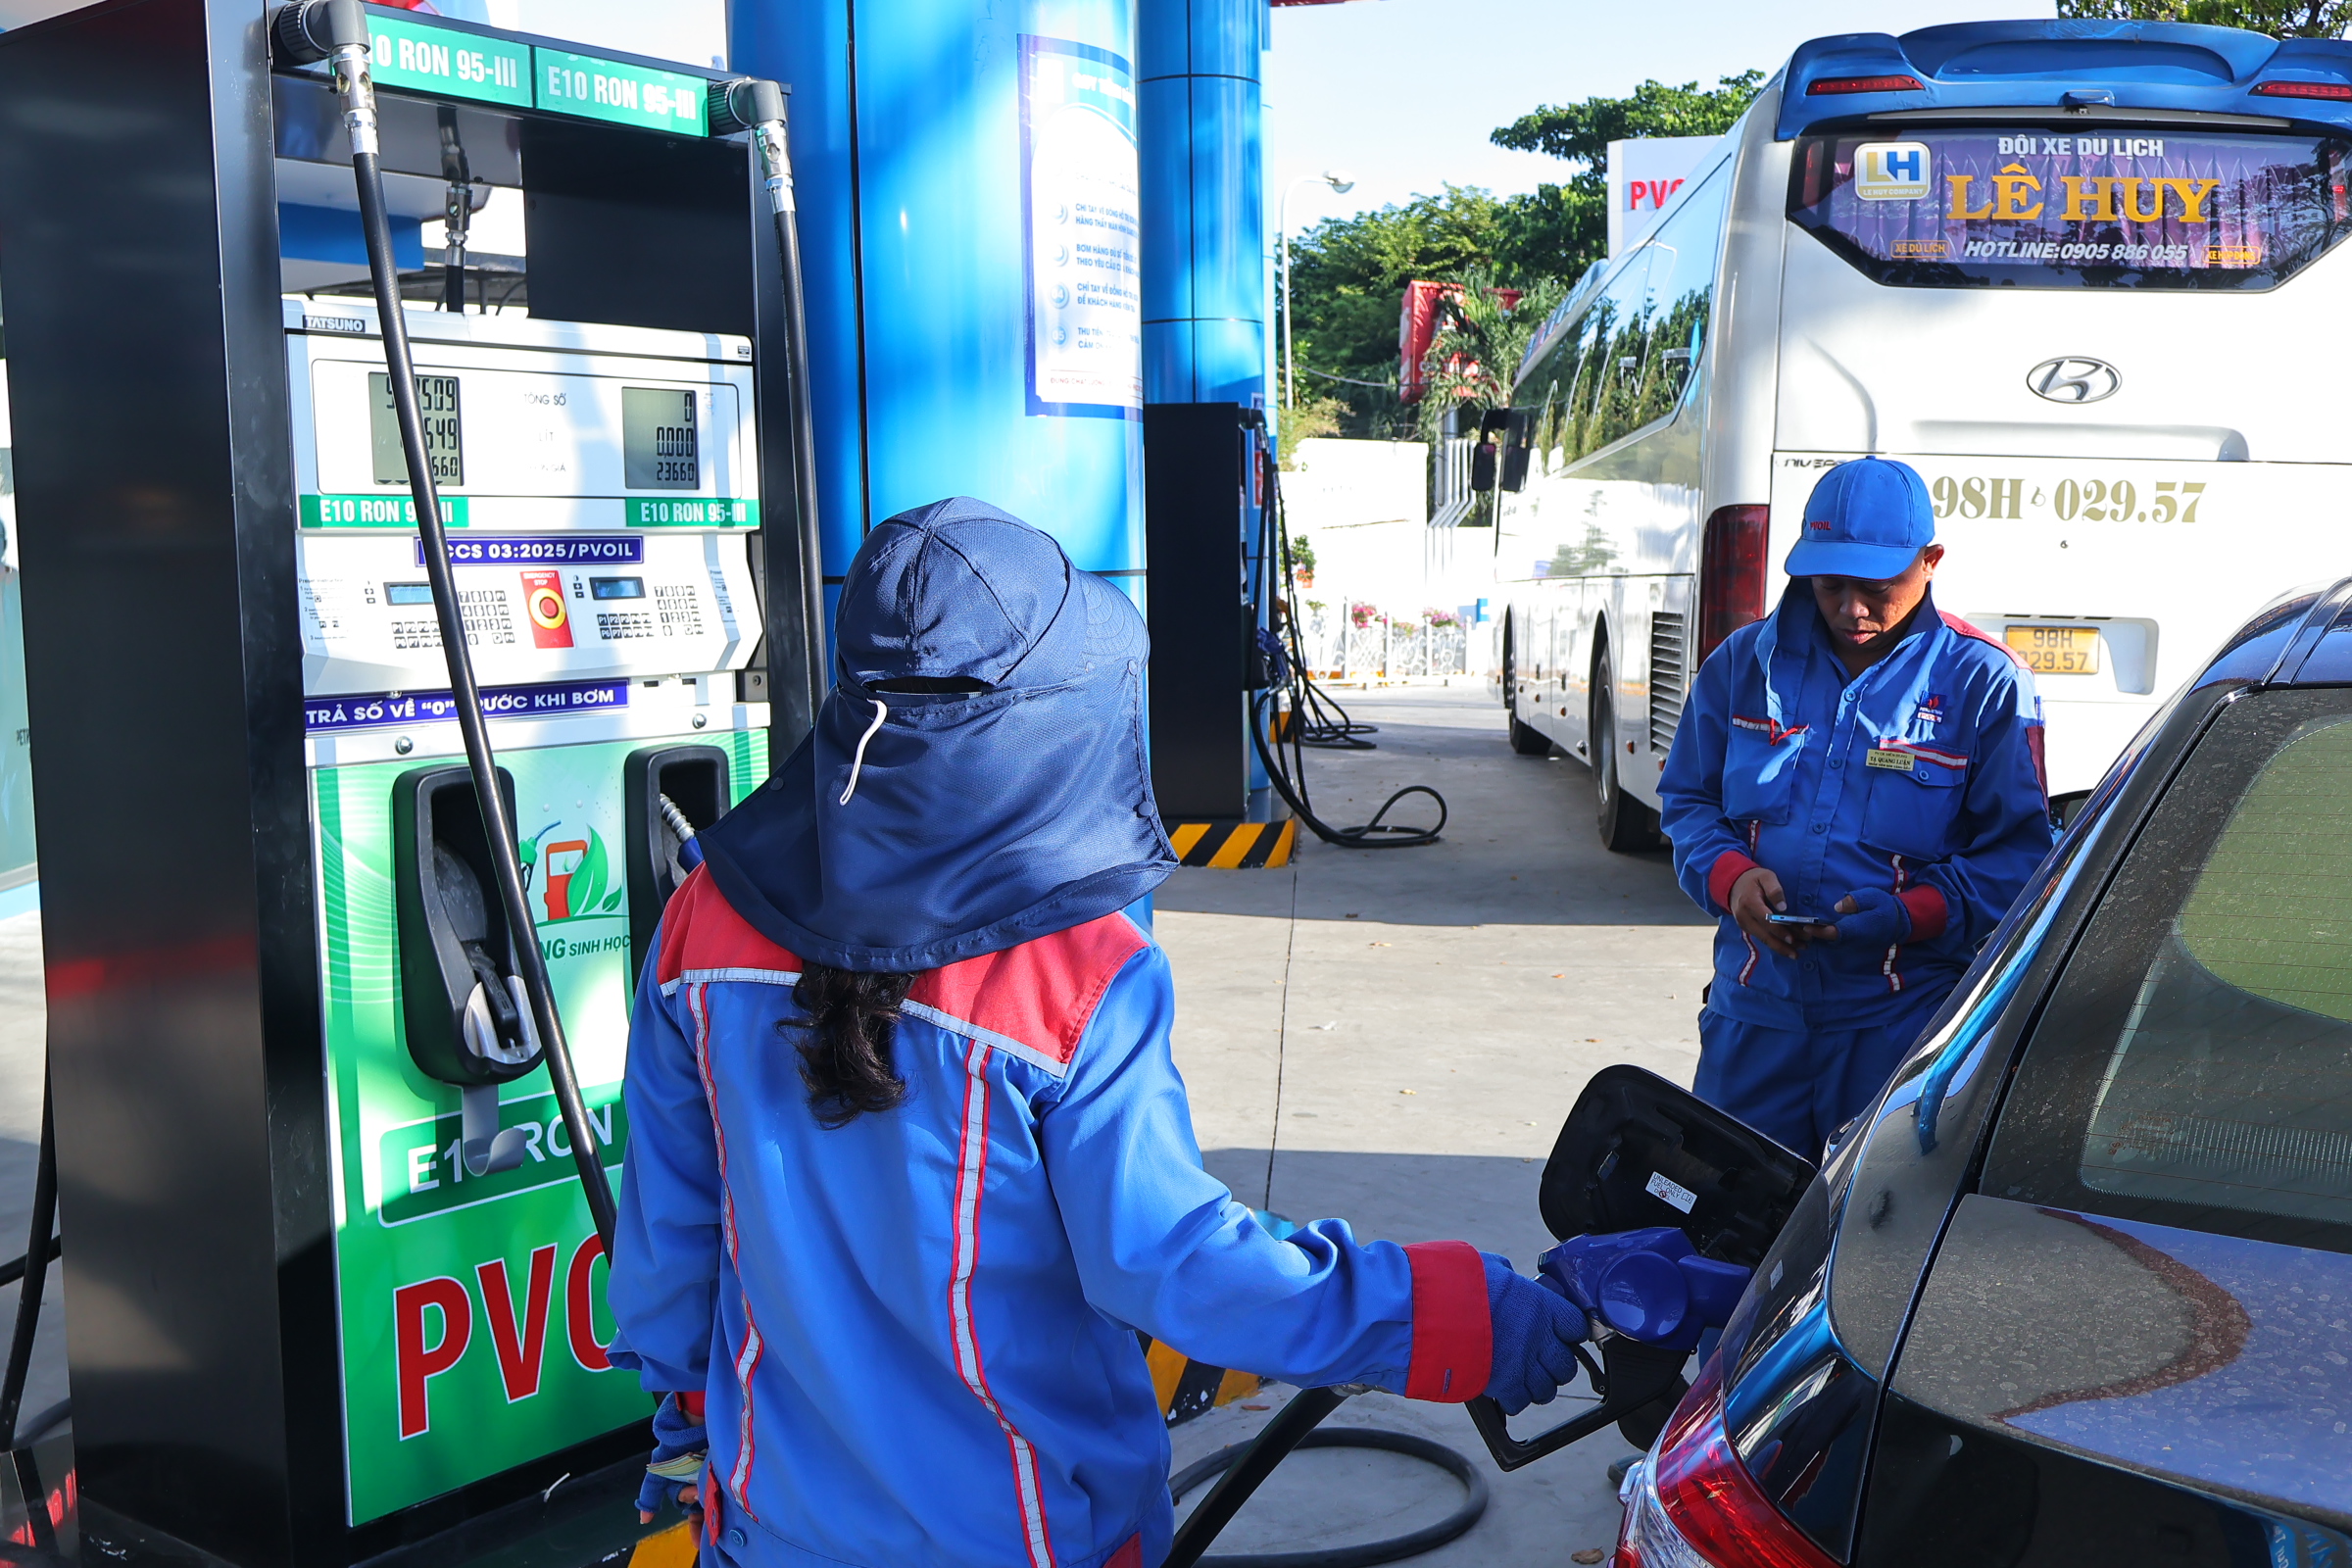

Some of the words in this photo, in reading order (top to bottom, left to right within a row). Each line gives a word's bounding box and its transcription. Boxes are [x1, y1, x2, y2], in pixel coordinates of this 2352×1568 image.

[368, 33, 392, 67] 10
[399, 38, 450, 76] RON
[457, 50, 516, 88] 95-III
[548, 66, 588, 100] E10
[593, 74, 637, 110] RON
[643, 82, 697, 120] 95-III
[1998, 134, 2036, 158] ĐỘI
[2042, 137, 2072, 155] XE
[2077, 138, 2109, 156] DU
[2113, 138, 2164, 161] LỊCH
[1866, 151, 1920, 182] LH
[1946, 163, 2044, 220] LÊ
[2060, 175, 2221, 222] HUY
[2112, 245, 2148, 260] 886
[2150, 245, 2188, 261] 055
[306, 317, 363, 332] TATSUNO
[553, 392, 566, 406] SỐ
[684, 393, 693, 422] 0
[656, 462, 695, 481] 23660
[319, 500, 355, 522] E10
[361, 500, 400, 522] RON
[1933, 476, 2026, 519] 98H
[2054, 478, 2207, 523] 029.57
[641, 502, 668, 522] E10
[673, 502, 705, 522] RON
[708, 503, 746, 522] 95-III
[1810, 520, 1832, 530] PVOIL
[2034, 629, 2073, 649] 98H
[306, 704, 347, 724] TRẢ
[354, 701, 384, 720] SỐ
[389, 698, 416, 718] VỀ
[479, 694, 528, 711] ƯỚC
[534, 693, 566, 708] KHI
[572, 689, 614, 705] BƠM
[539, 938, 565, 960] NG
[569, 939, 600, 956] SINH
[604, 935, 630, 952] HỌC
[408, 1139, 463, 1194] E1
[1650, 1179, 1663, 1190] FUEL
[1666, 1188, 1680, 1199] ONLY
[1653, 1173, 1682, 1193] UNLEADED
